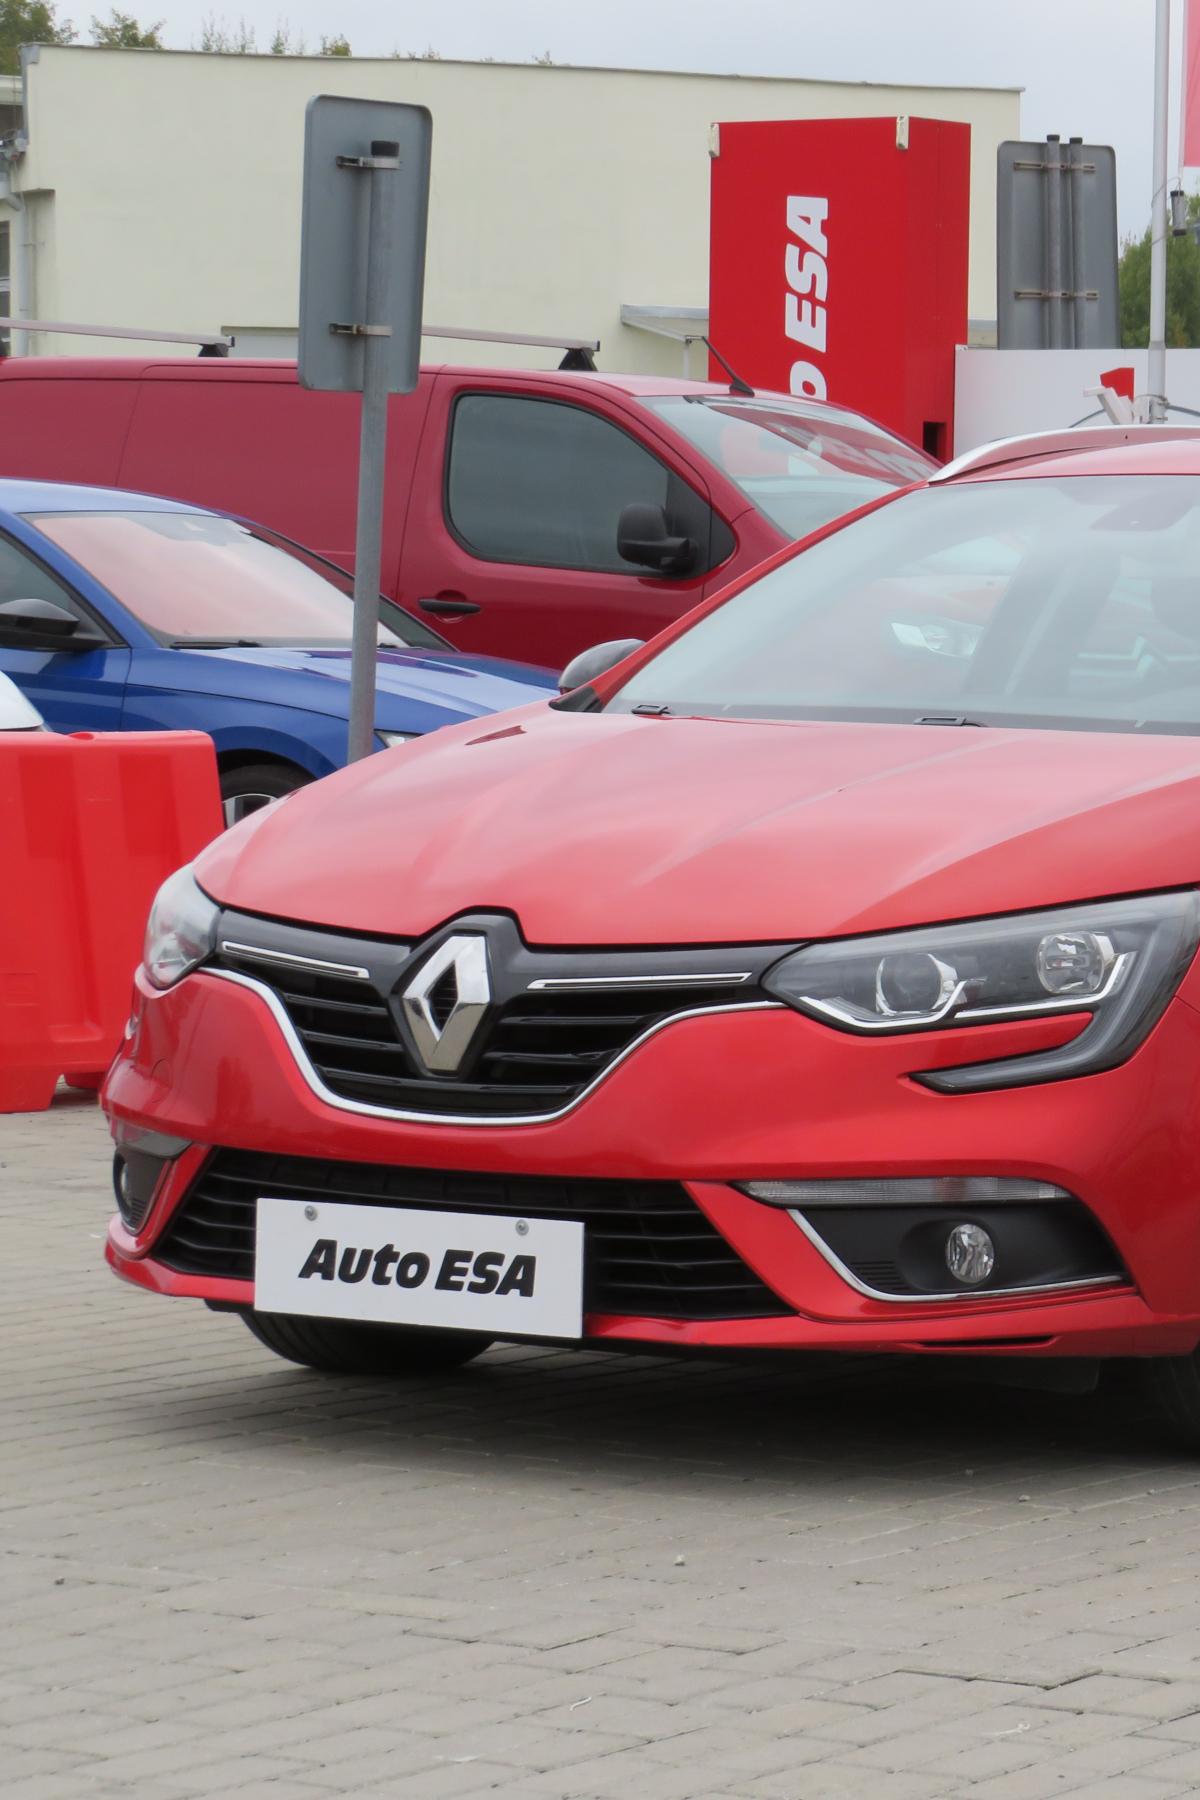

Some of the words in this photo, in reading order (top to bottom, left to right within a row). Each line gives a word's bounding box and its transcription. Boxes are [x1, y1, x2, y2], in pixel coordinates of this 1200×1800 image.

[785, 195, 828, 353] ESA
[298, 1238, 430, 1289] Auto
[434, 1248, 537, 1298] ESA
